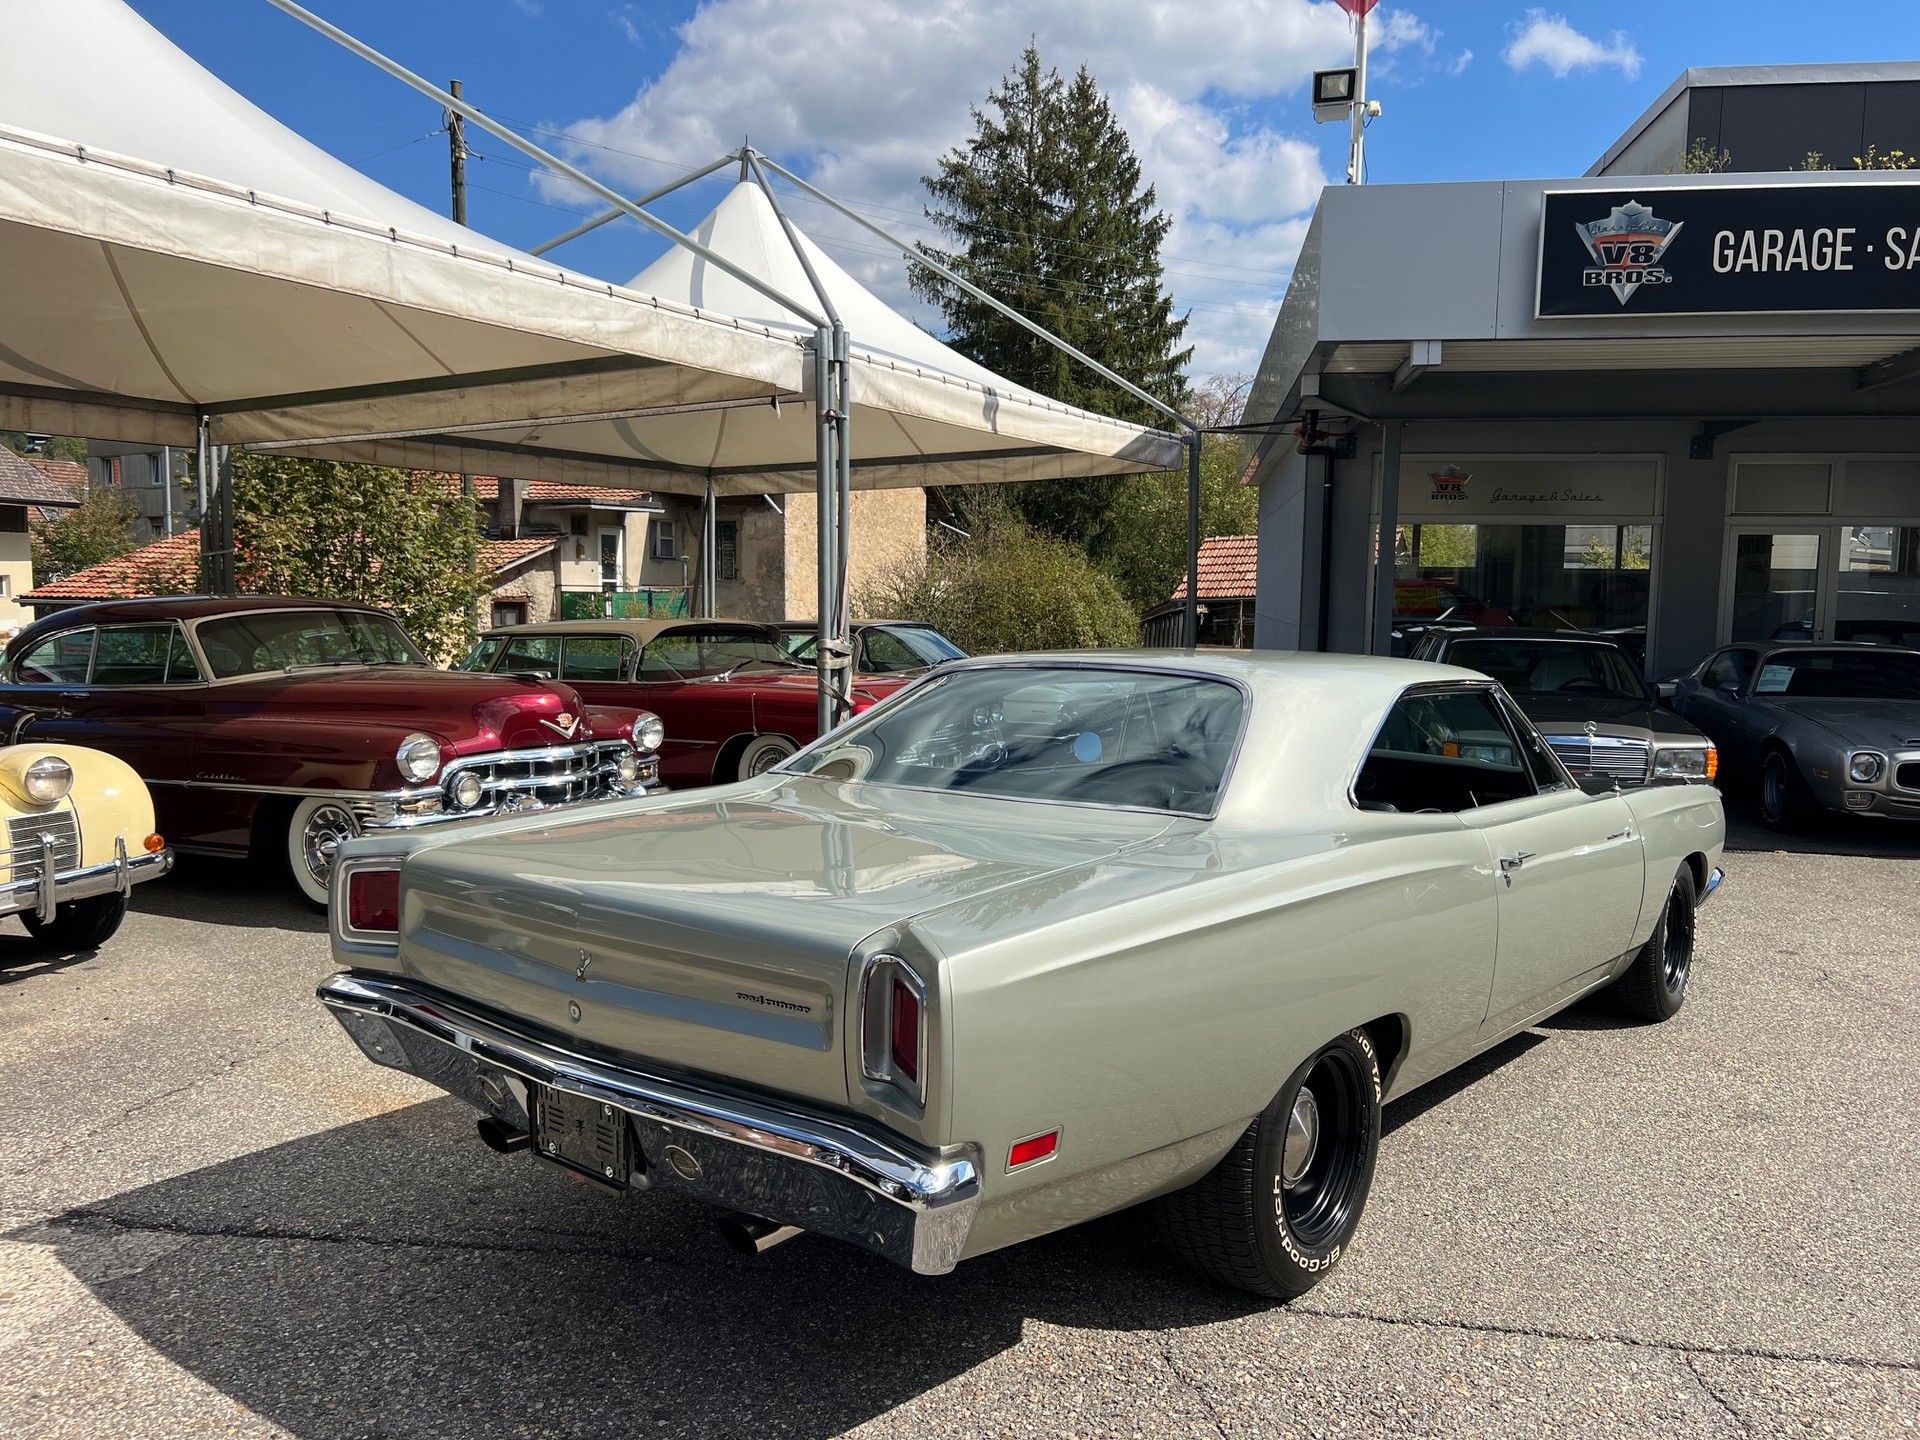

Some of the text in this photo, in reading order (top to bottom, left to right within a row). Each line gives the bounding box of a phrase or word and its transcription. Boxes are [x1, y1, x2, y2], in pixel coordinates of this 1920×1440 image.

[1600, 242, 1656, 266] V8
[1712, 227, 1856, 274] GARAGE
[1582, 268, 1673, 287] BROS.
[1438, 482, 1462, 492] V8
[1490, 487, 1549, 504] Garage
[1560, 488, 1604, 502] Sales
[736, 992, 811, 1013] road runner
[1371, 1061, 1382, 1104] T/A
[1272, 1174, 1340, 1273] BFGoodrich
